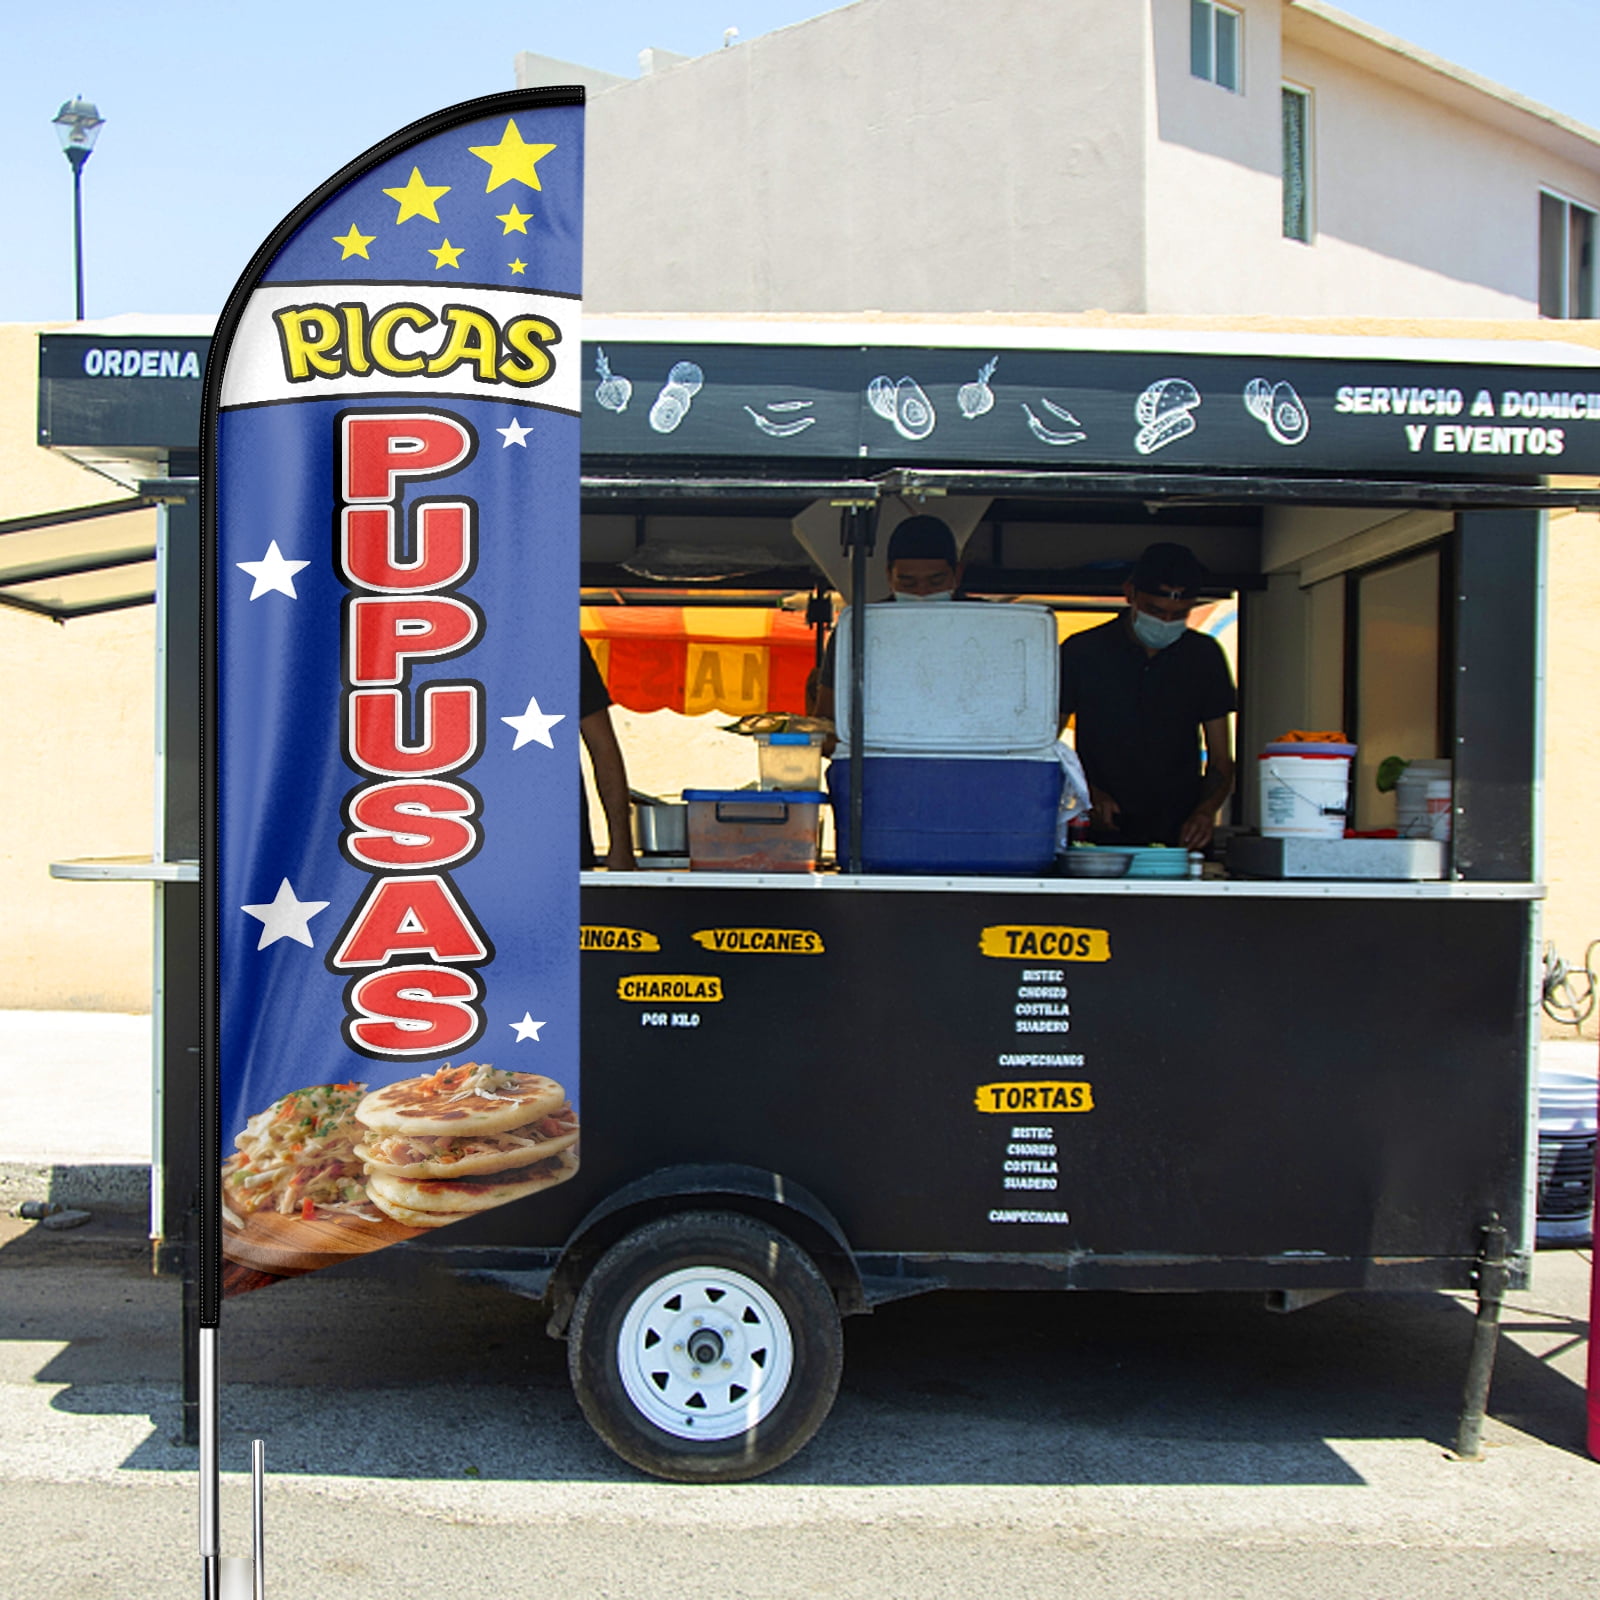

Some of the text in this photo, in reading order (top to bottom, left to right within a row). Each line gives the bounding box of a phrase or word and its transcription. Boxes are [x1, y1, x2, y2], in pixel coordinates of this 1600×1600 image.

[272, 302, 562, 388] RICAS
[84, 348, 200, 378] ORDENA
[1335, 386, 1464, 416] SERVICIO
[1470, 390, 1496, 418] A
[1404, 424, 1566, 455] Y EVENTOS
[326, 407, 495, 1062] PUPUSAS
[580, 929, 643, 949] INGAS
[713, 931, 816, 951] VOLCANES
[1005, 930, 1091, 957] TACOS
[1022, 969, 1065, 982] BISTEC
[623, 981, 719, 998] CHAROLAS
[1015, 1003, 1070, 1016] COSTILLA
[641, 1012, 701, 1027] POR KILO
[1015, 1021, 1070, 1033] SUADERO
[990, 1087, 1084, 1110] TORTAS
[1010, 1127, 1054, 1140] BISTEC
[1006, 1144, 1058, 1157] CHORIZO
[1003, 1160, 1059, 1174] COSTILLA
[1003, 1177, 1058, 1190] SUADERO
